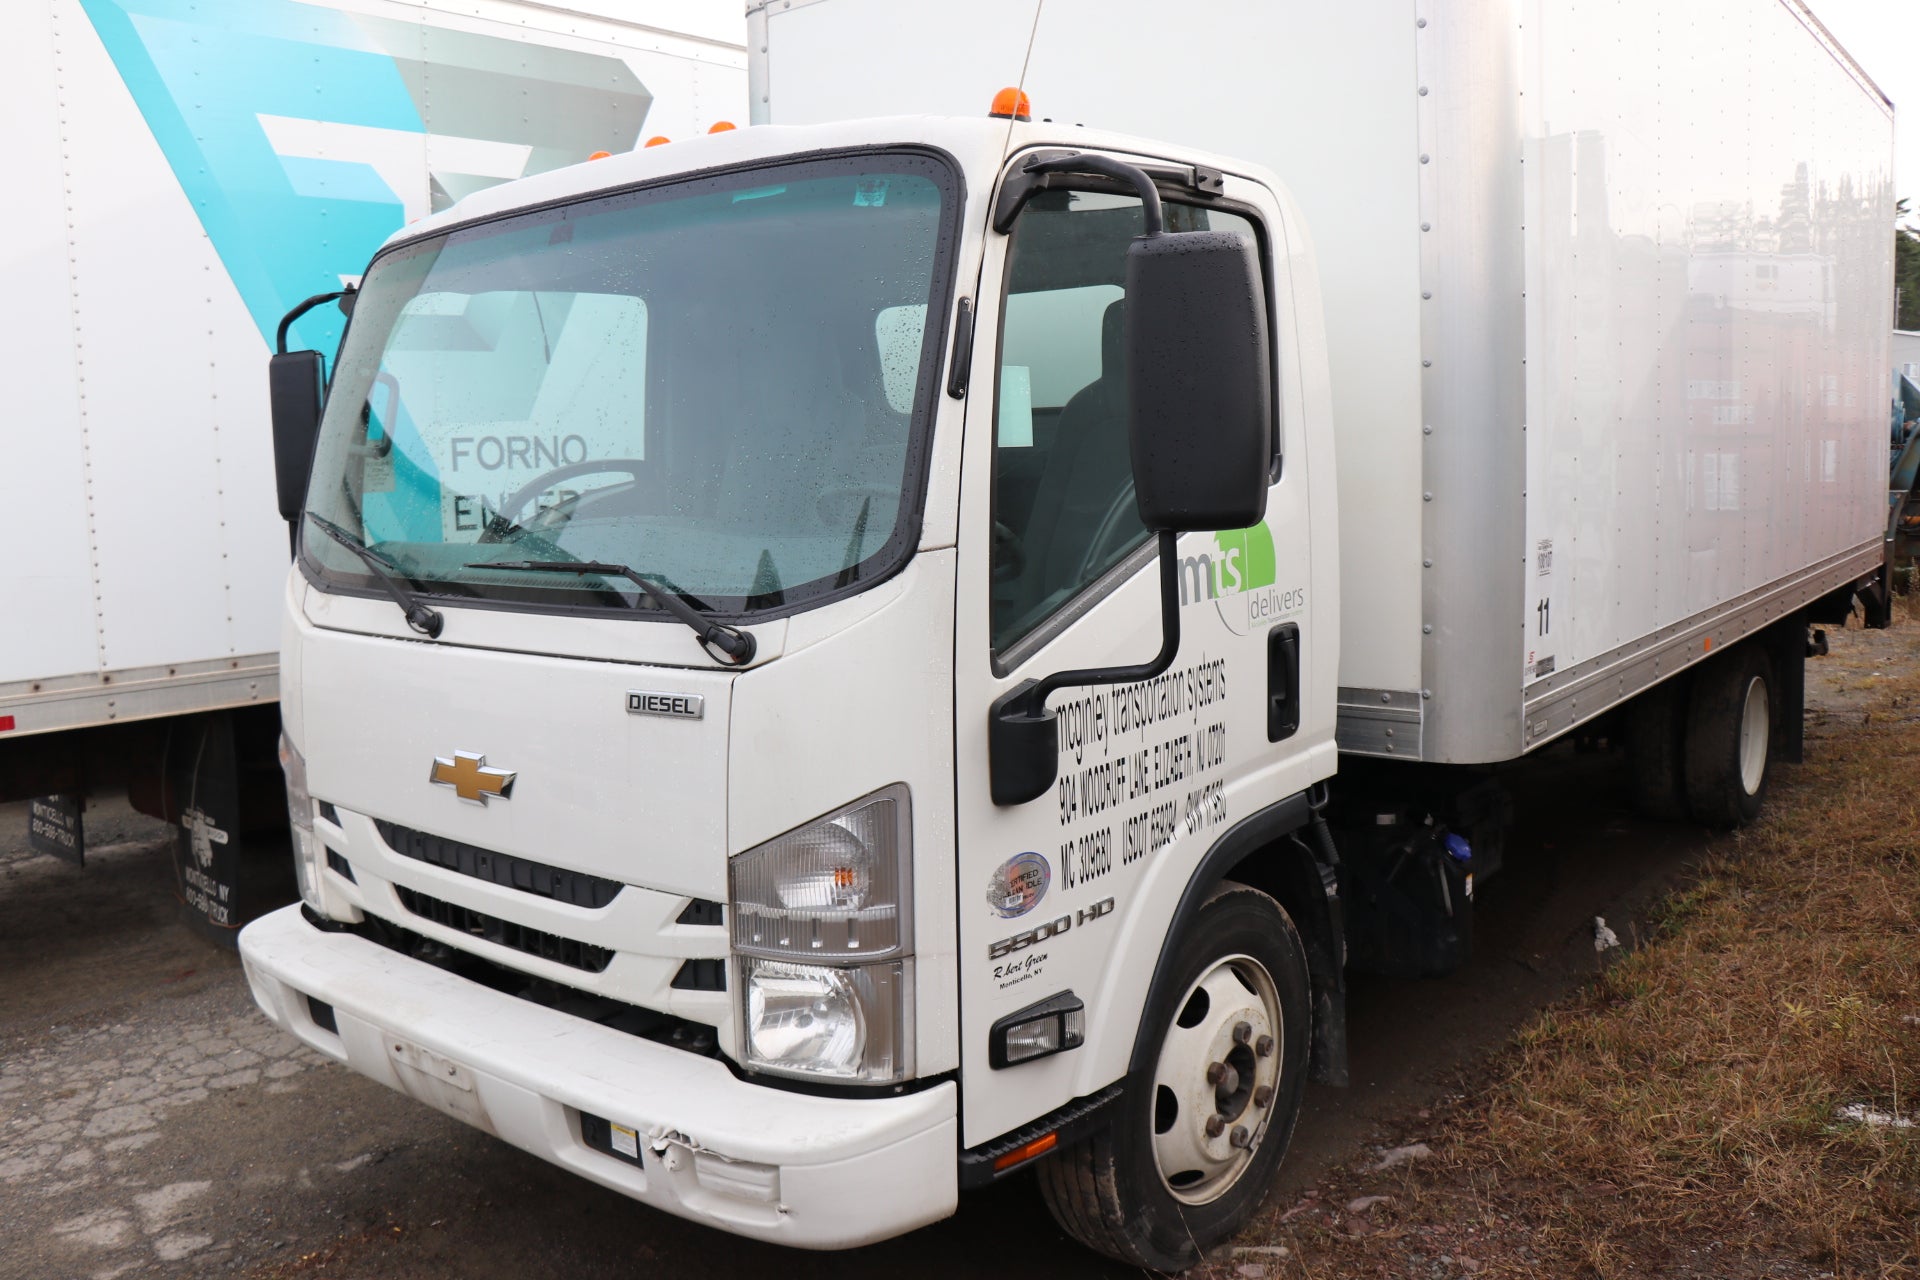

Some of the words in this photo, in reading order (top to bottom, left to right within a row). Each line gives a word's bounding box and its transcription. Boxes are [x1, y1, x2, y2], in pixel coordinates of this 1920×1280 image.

[451, 434, 587, 472] FORNO
[1177, 539, 1242, 606] mts
[1250, 588, 1304, 620] delivers
[1537, 597, 1550, 637] 11
[629, 694, 695, 715] DIESEL
[1056, 685, 1109, 765] mcginley
[1111, 668, 1184, 743] transportation
[1187, 651, 1226, 725] systems
[1059, 774, 1077, 826] 904
[1079, 757, 1126, 818] WOODRUFF
[1060, 840, 1076, 892] MC
[1078, 825, 1112, 884] 309680
[1122, 812, 1149, 866] USDOT
[1008, 869, 1039, 889] ERTIFIED
[988, 914, 1072, 961] 5500
[1076, 896, 1115, 928] HD
[993, 961, 1023, 981] Rbert
[1025, 954, 1048, 972] Green
[1034, 967, 1043, 976] NY
